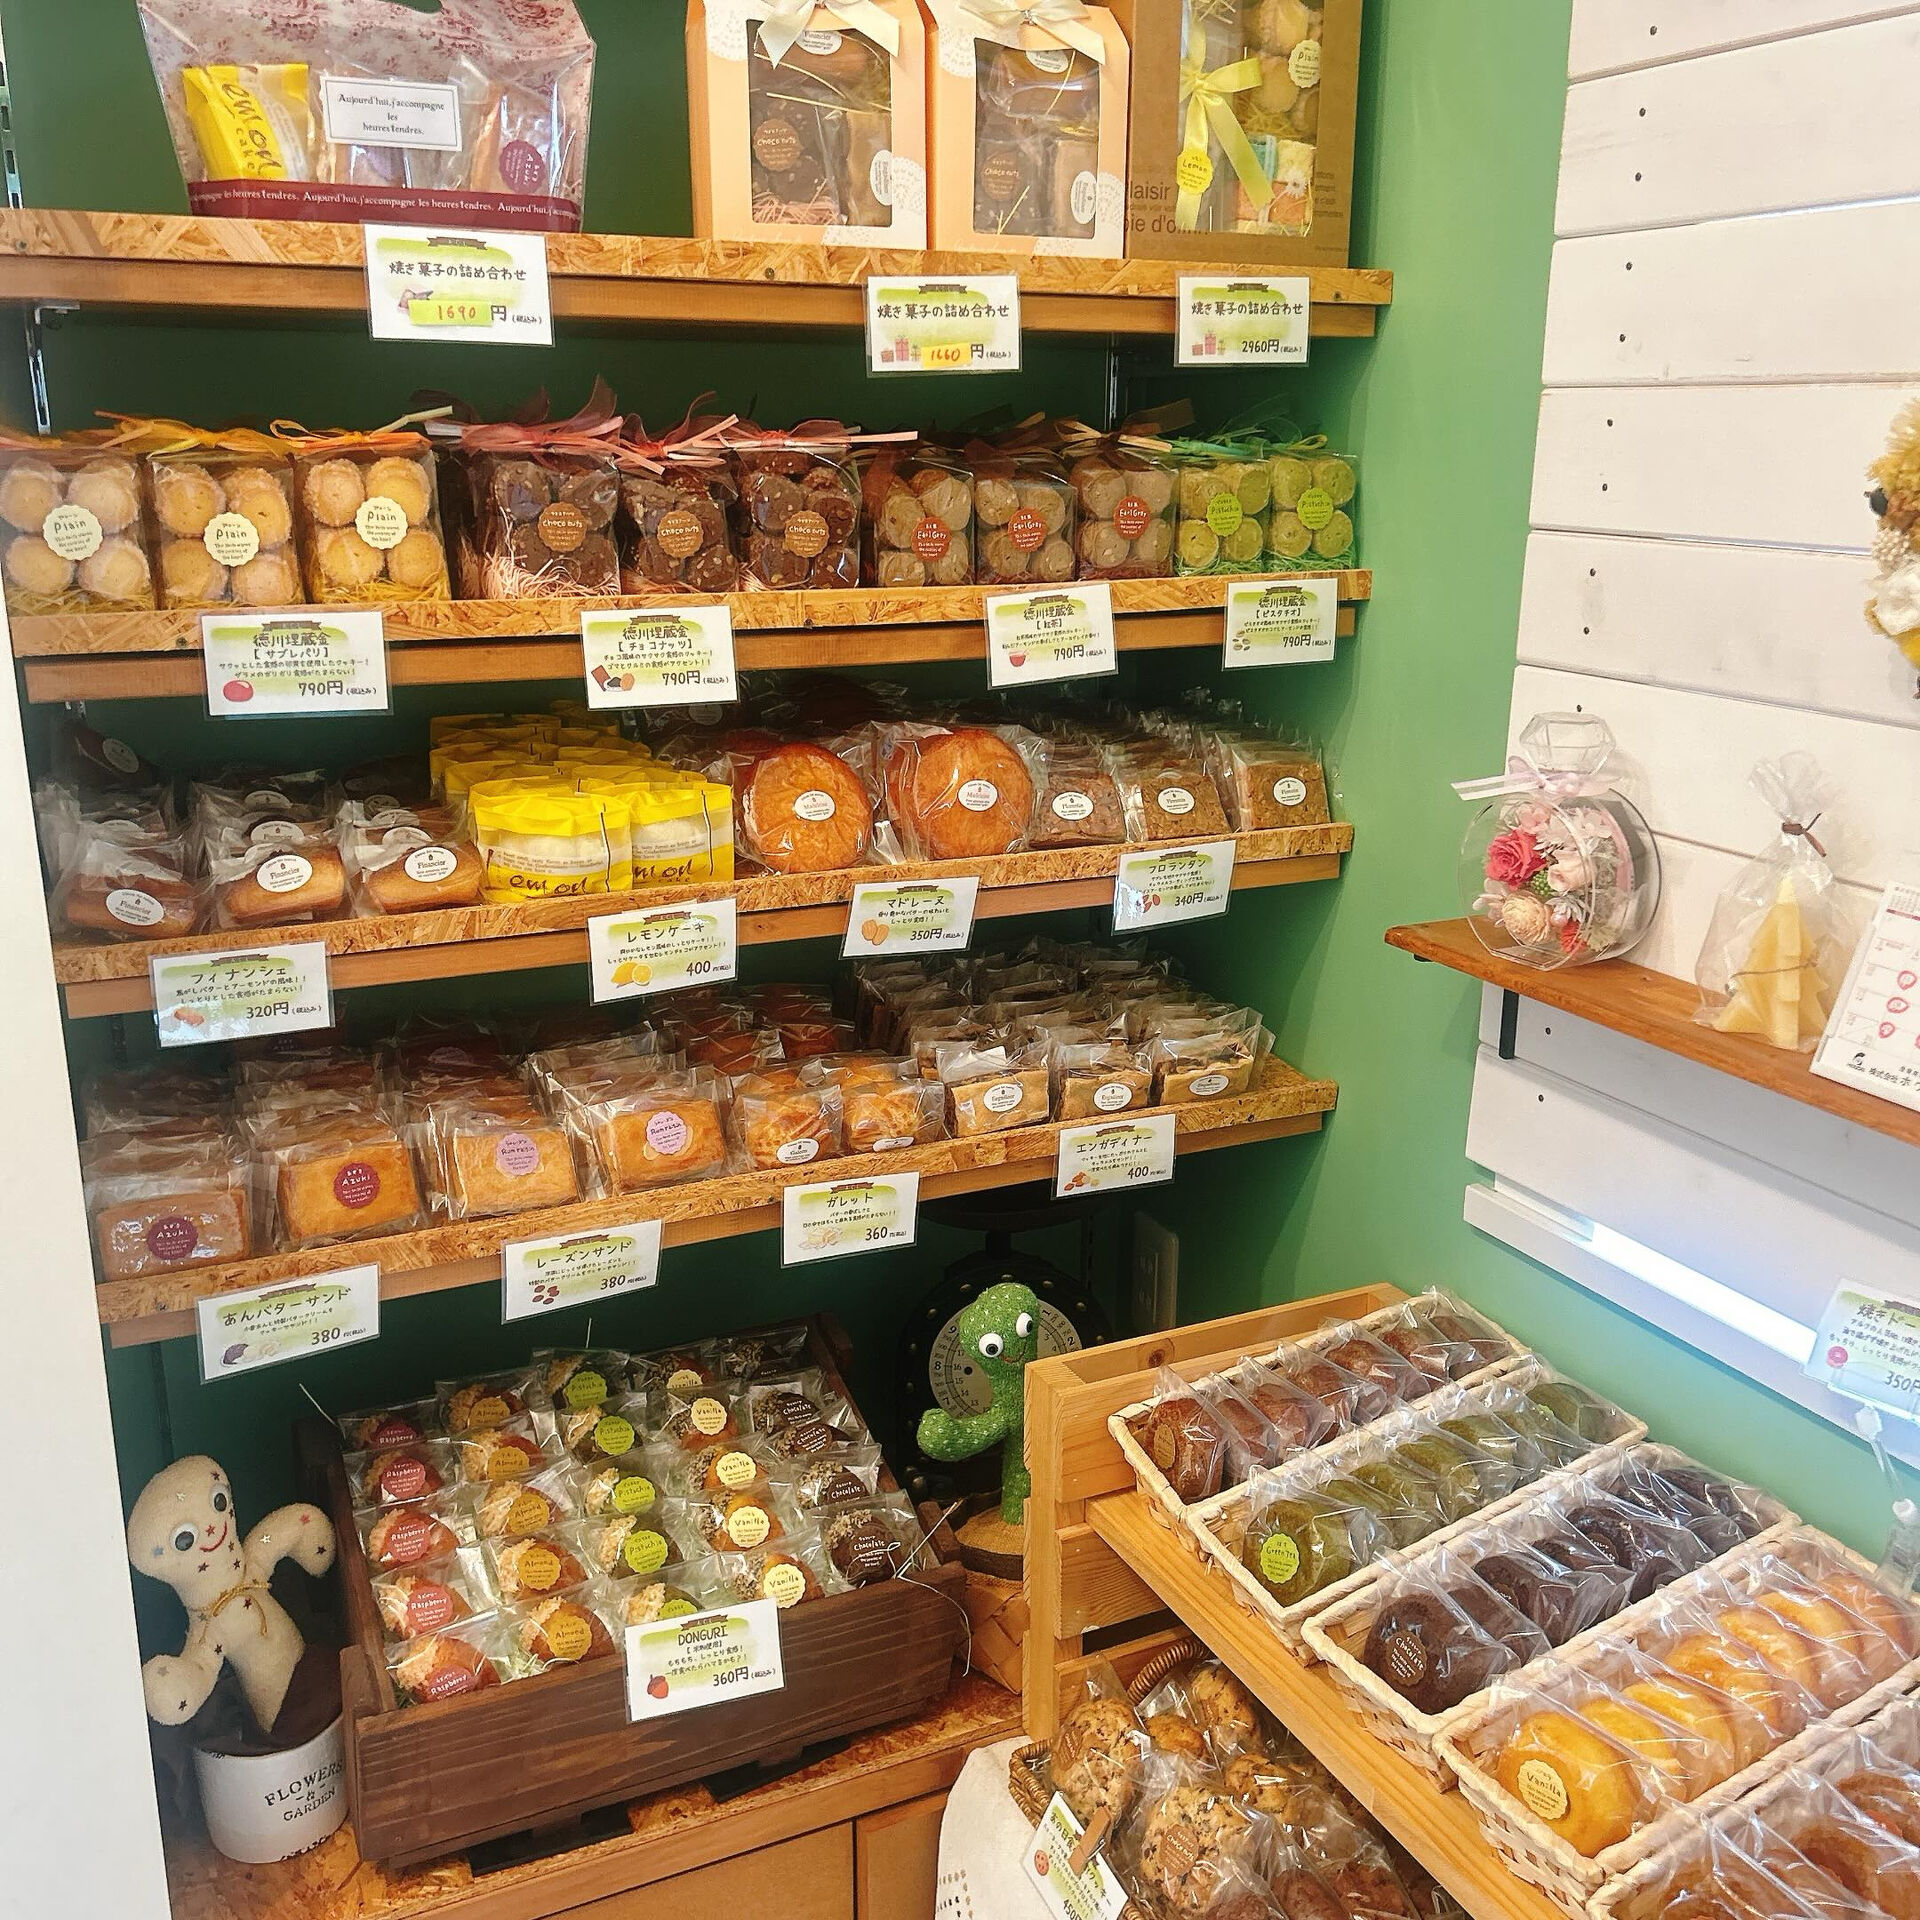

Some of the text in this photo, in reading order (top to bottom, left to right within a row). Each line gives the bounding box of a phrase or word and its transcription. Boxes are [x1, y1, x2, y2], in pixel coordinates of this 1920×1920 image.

[387, 113, 398, 121] les
[1129, 180, 1172, 201] laisir
[389, 260, 527, 281] 焼き菓子の詰め合わせ
[437, 305, 476, 321] 1690
[877, 303, 1010, 320] 焼き菓子の詰め合わせ
[1191, 301, 1304, 316] 焼き菓子の詰め合わせ
[931, 348, 961, 362] 1660
[367, 511, 397, 522] Plain
[54, 520, 87, 534] Plain
[216, 528, 247, 540] Plain
[1149, 859, 1207, 874] フロランタン
[886, 895, 945, 909] マドレーヌ
[627, 922, 705, 943] レモンケーキ
[191, 965, 287, 985] フィナンシェ
[686, 960, 711, 977] 400
[1076, 1135, 1153, 1153] エンガディナー
[1127, 1165, 1149, 1180] 400
[342, 1175, 370, 1187] Azuki
[827, 1192, 874, 1208] ガレット
[156, 1229, 188, 1240] Azuki
[865, 1226, 888, 1242] 360
[536, 1240, 633, 1269] レーズンサンド
[600, 1274, 626, 1291] 380
[223, 1287, 352, 1327] あんバターサンド
[311, 1327, 341, 1346] 380
[933, 1360, 941, 1371] 8
[696, 1407, 721, 1415] Vanilla
[783, 1404, 812, 1416] Chocolate
[797, 1427, 826, 1445] Chocolate
[386, 1467, 421, 1478] Raspberry
[722, 1461, 750, 1472] Vanilla
[831, 1486, 861, 1499] Chocolate
[735, 1517, 764, 1527] Vanilla
[391, 1528, 425, 1541] Raspberry
[854, 1539, 886, 1552] Chocolate
[525, 1559, 553, 1568] Almond
[769, 1574, 799, 1589] Vanilla
[411, 1598, 447, 1610] Raspberry
[555, 1628, 584, 1640] Almond
[678, 1625, 729, 1647] DONGURI
[1395, 1637, 1424, 1671] Chocolate
[431, 1674, 468, 1695] Raspberry
[264, 1758, 344, 1807] FLOWERS
[1526, 1771, 1561, 1798] Vanilla
[283, 1786, 336, 1822] GARDEN
